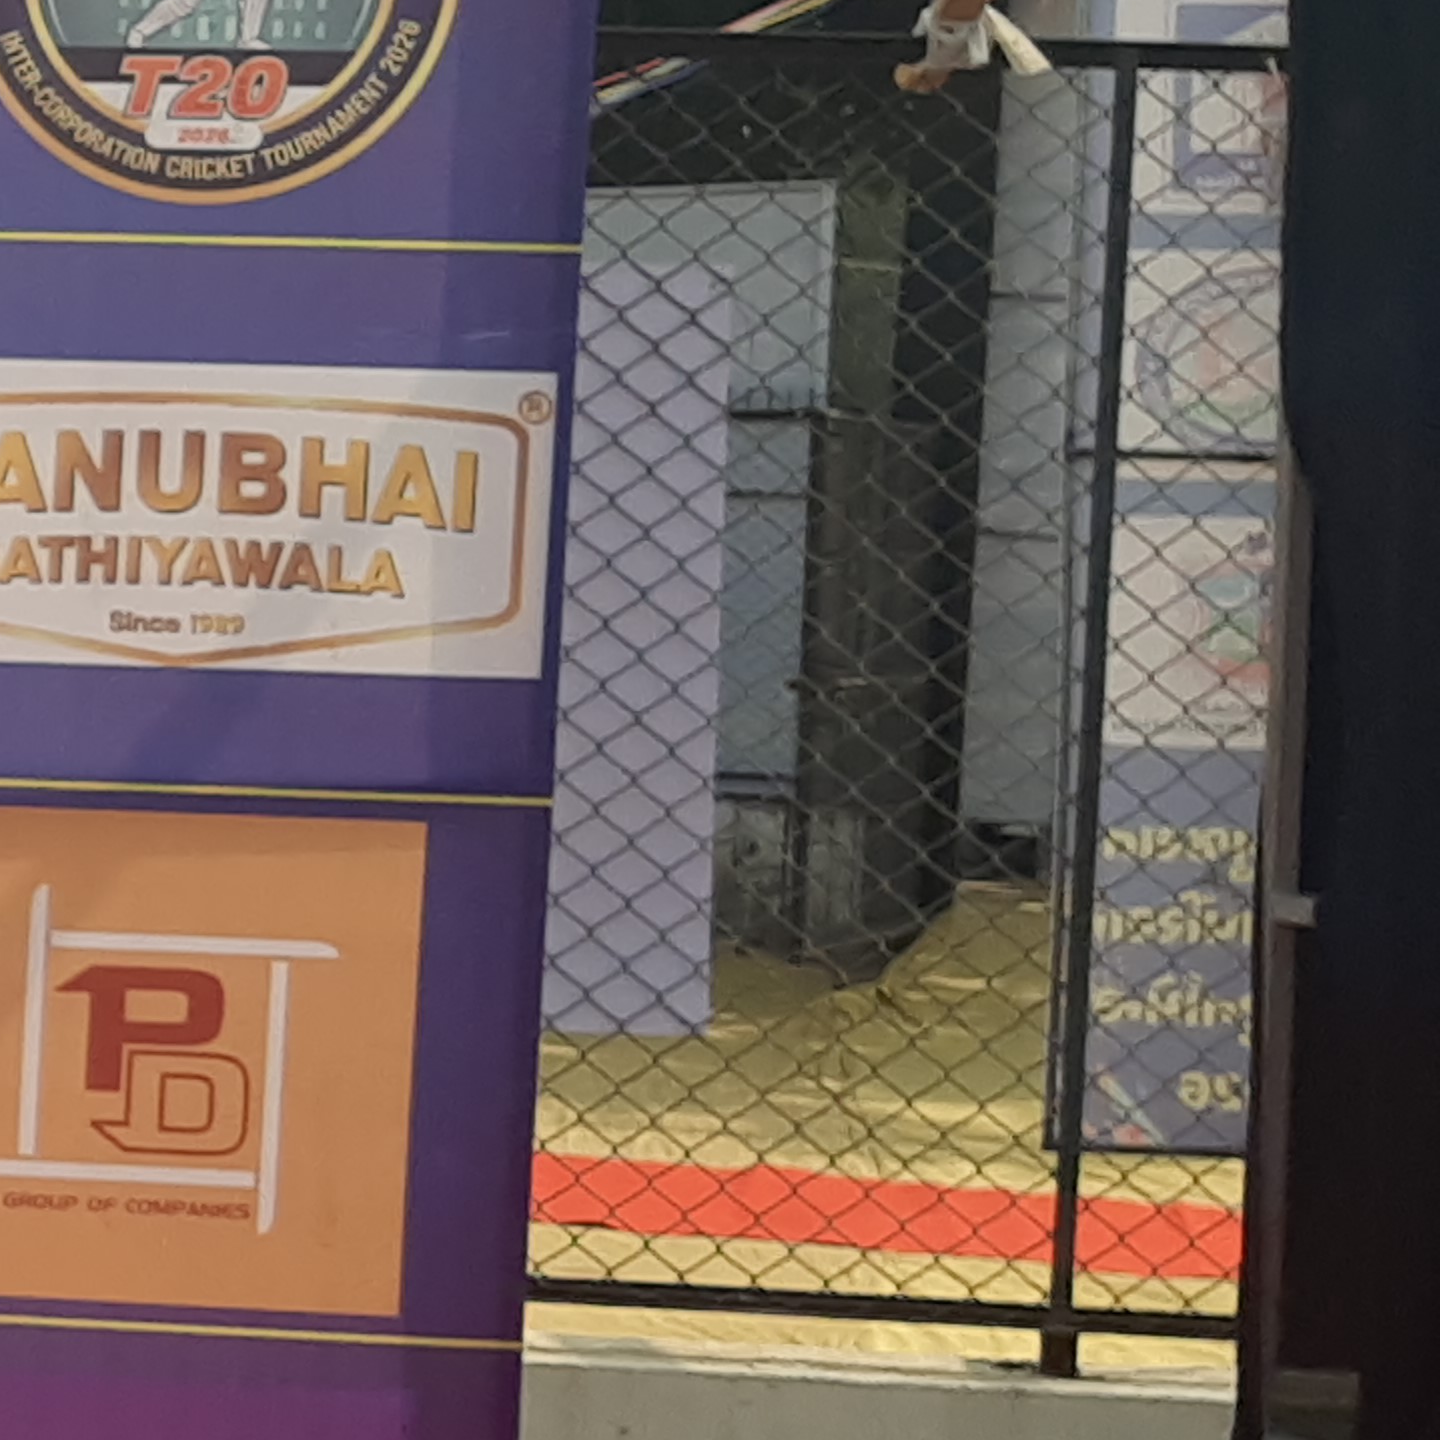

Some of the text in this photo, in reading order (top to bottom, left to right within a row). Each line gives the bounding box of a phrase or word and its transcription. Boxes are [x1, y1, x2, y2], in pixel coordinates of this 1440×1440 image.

[121, 54, 289, 120] T20
[165, 148, 257, 181] CRICKET
[261, 77, 389, 173] TOURNAMENT
[109, 609, 180, 634] Since
